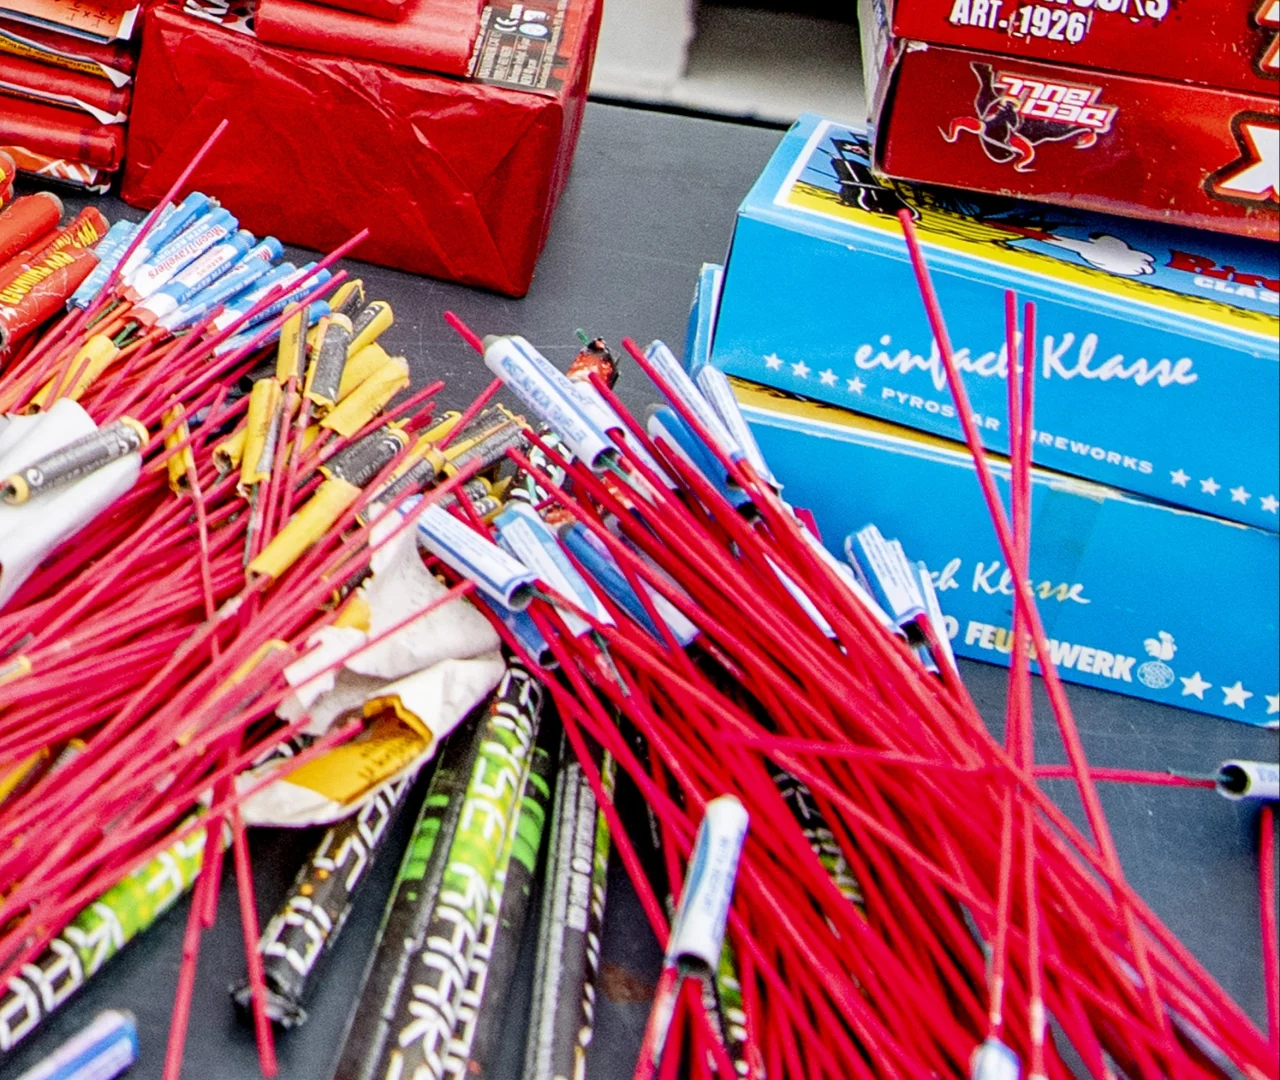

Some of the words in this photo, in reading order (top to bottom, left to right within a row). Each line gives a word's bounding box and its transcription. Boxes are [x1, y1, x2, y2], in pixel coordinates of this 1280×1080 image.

[1016, 6, 1091, 45] 1926
[1041, 331, 1199, 388] Klasse
[880, 384, 1001, 434] PYROSAR
